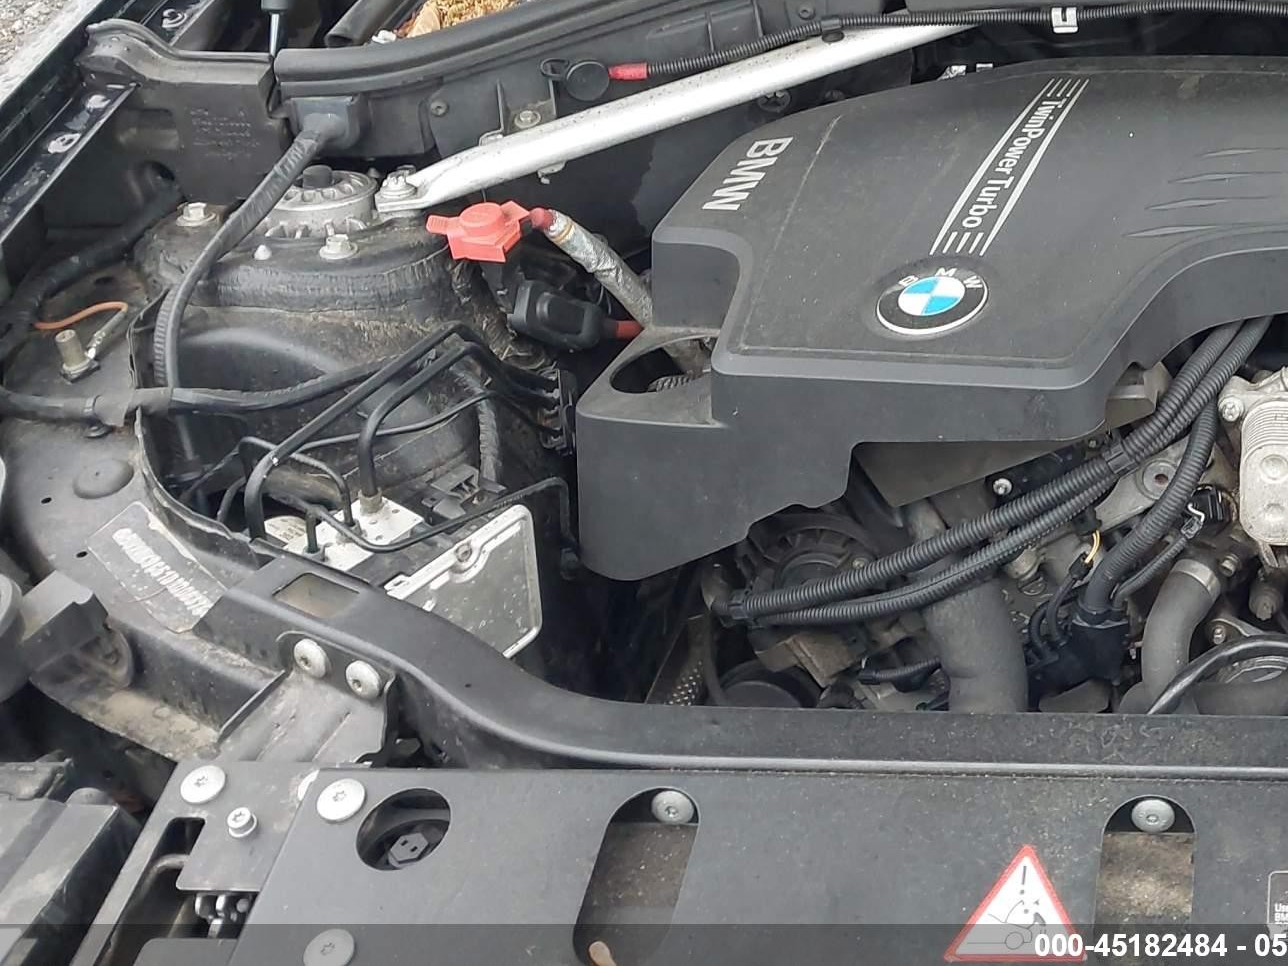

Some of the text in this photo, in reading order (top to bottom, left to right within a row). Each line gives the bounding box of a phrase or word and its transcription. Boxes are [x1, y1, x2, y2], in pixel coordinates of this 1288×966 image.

[702, 137, 794, 210] BMW
[962, 98, 1067, 228] TwinPower Turbo
[898, 267, 983, 288] BMW
